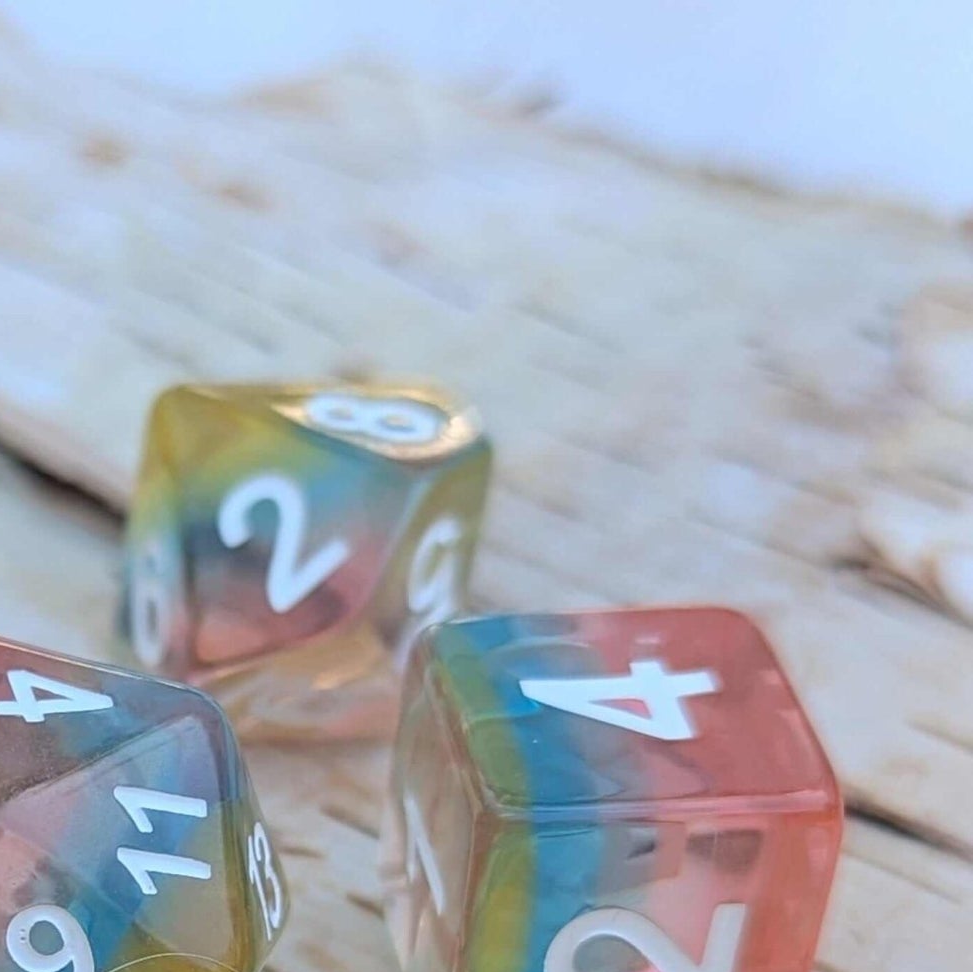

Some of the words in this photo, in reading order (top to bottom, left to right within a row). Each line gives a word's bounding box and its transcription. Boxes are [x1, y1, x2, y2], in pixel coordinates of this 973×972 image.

[306, 394, 439, 443] 8
[218, 474, 350, 613] 2
[519, 660, 721, 740] 4
[113, 785, 211, 895] 11
[248, 821, 283, 941] 13
